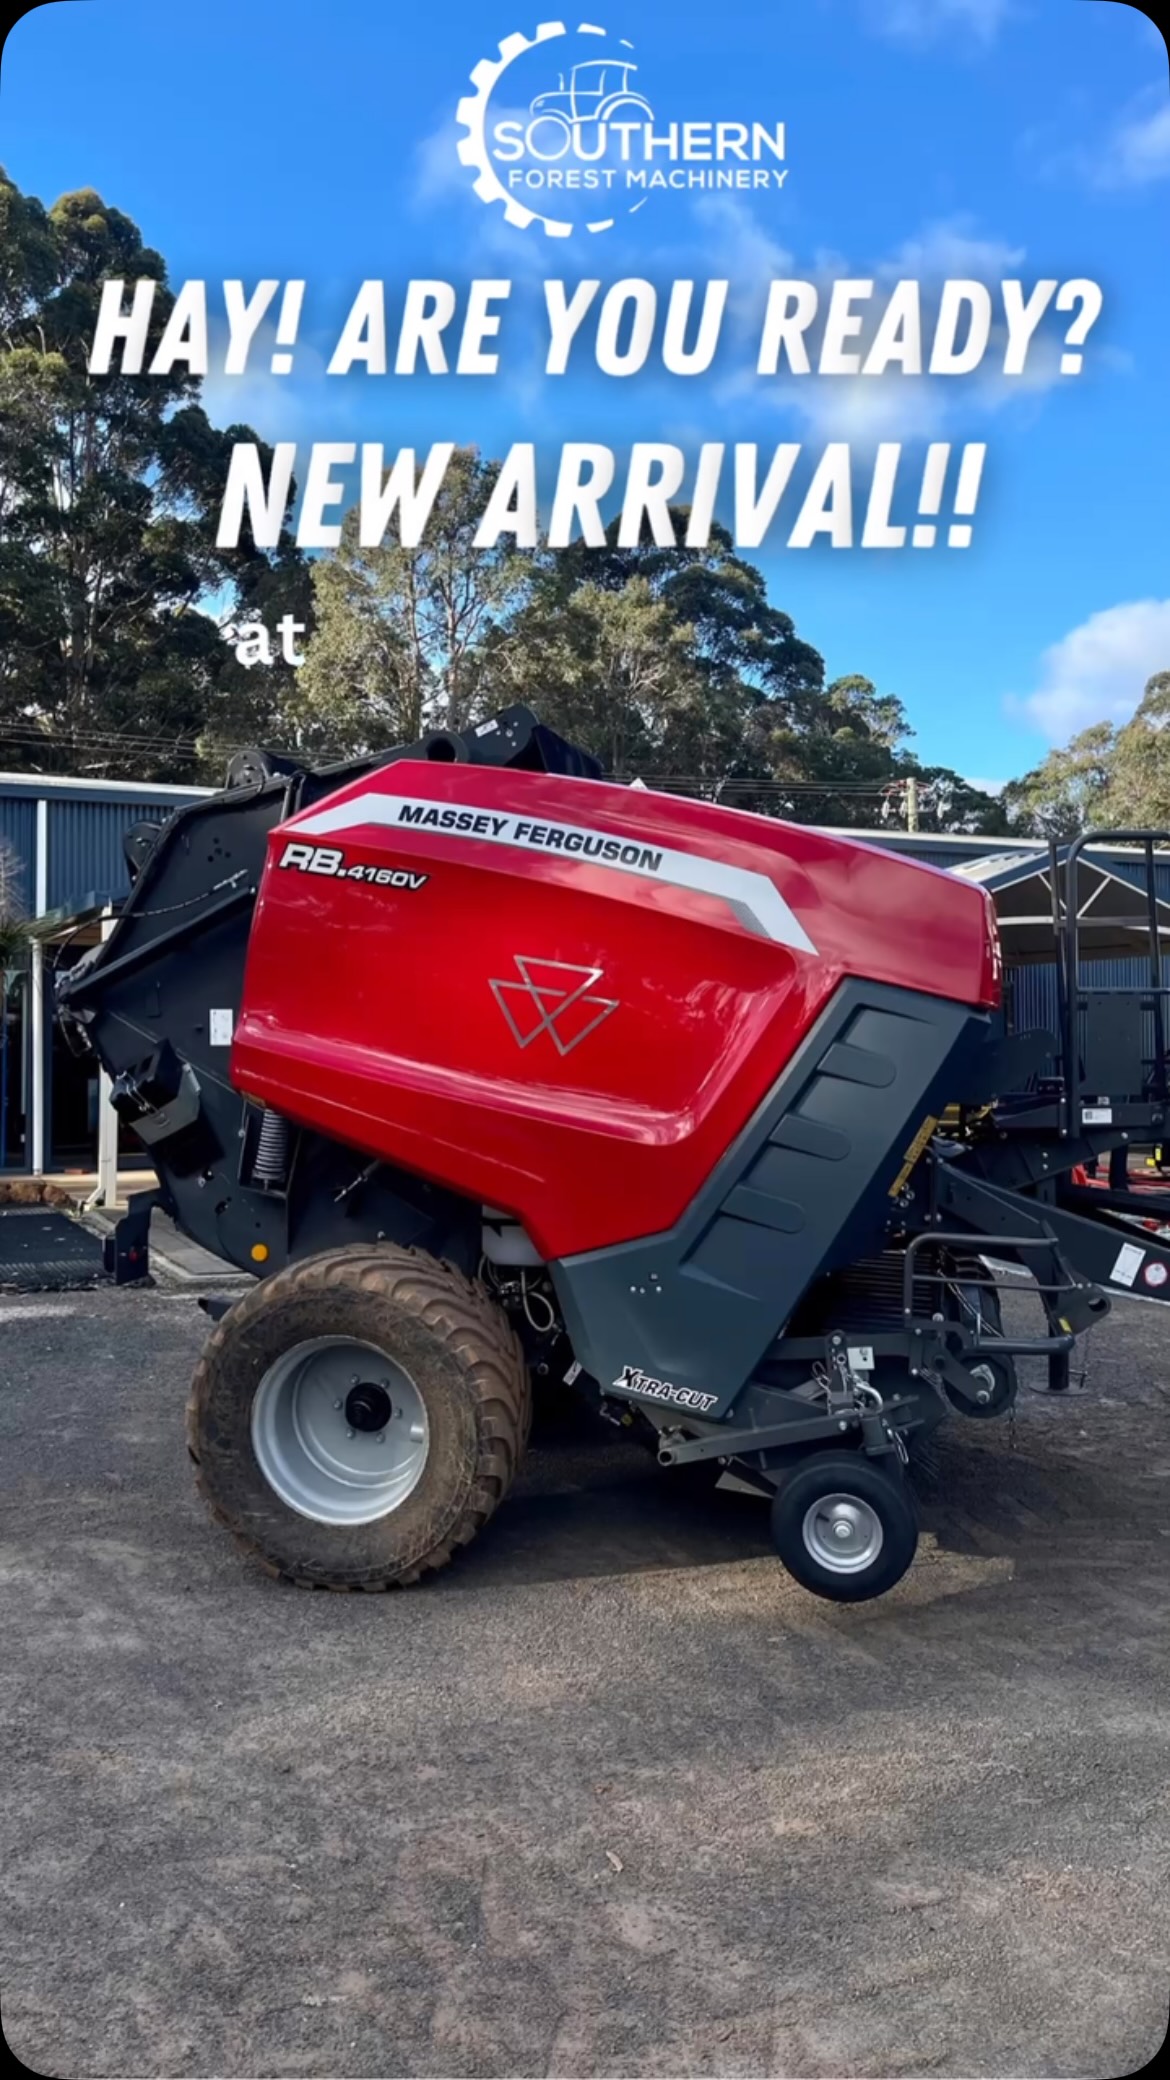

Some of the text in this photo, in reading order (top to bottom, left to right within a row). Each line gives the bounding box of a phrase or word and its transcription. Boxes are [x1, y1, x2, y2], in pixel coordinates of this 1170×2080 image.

[398, 804, 664, 872] MASSEY FERGUSON
[612, 1365, 719, 1411] XTRA-CUT
